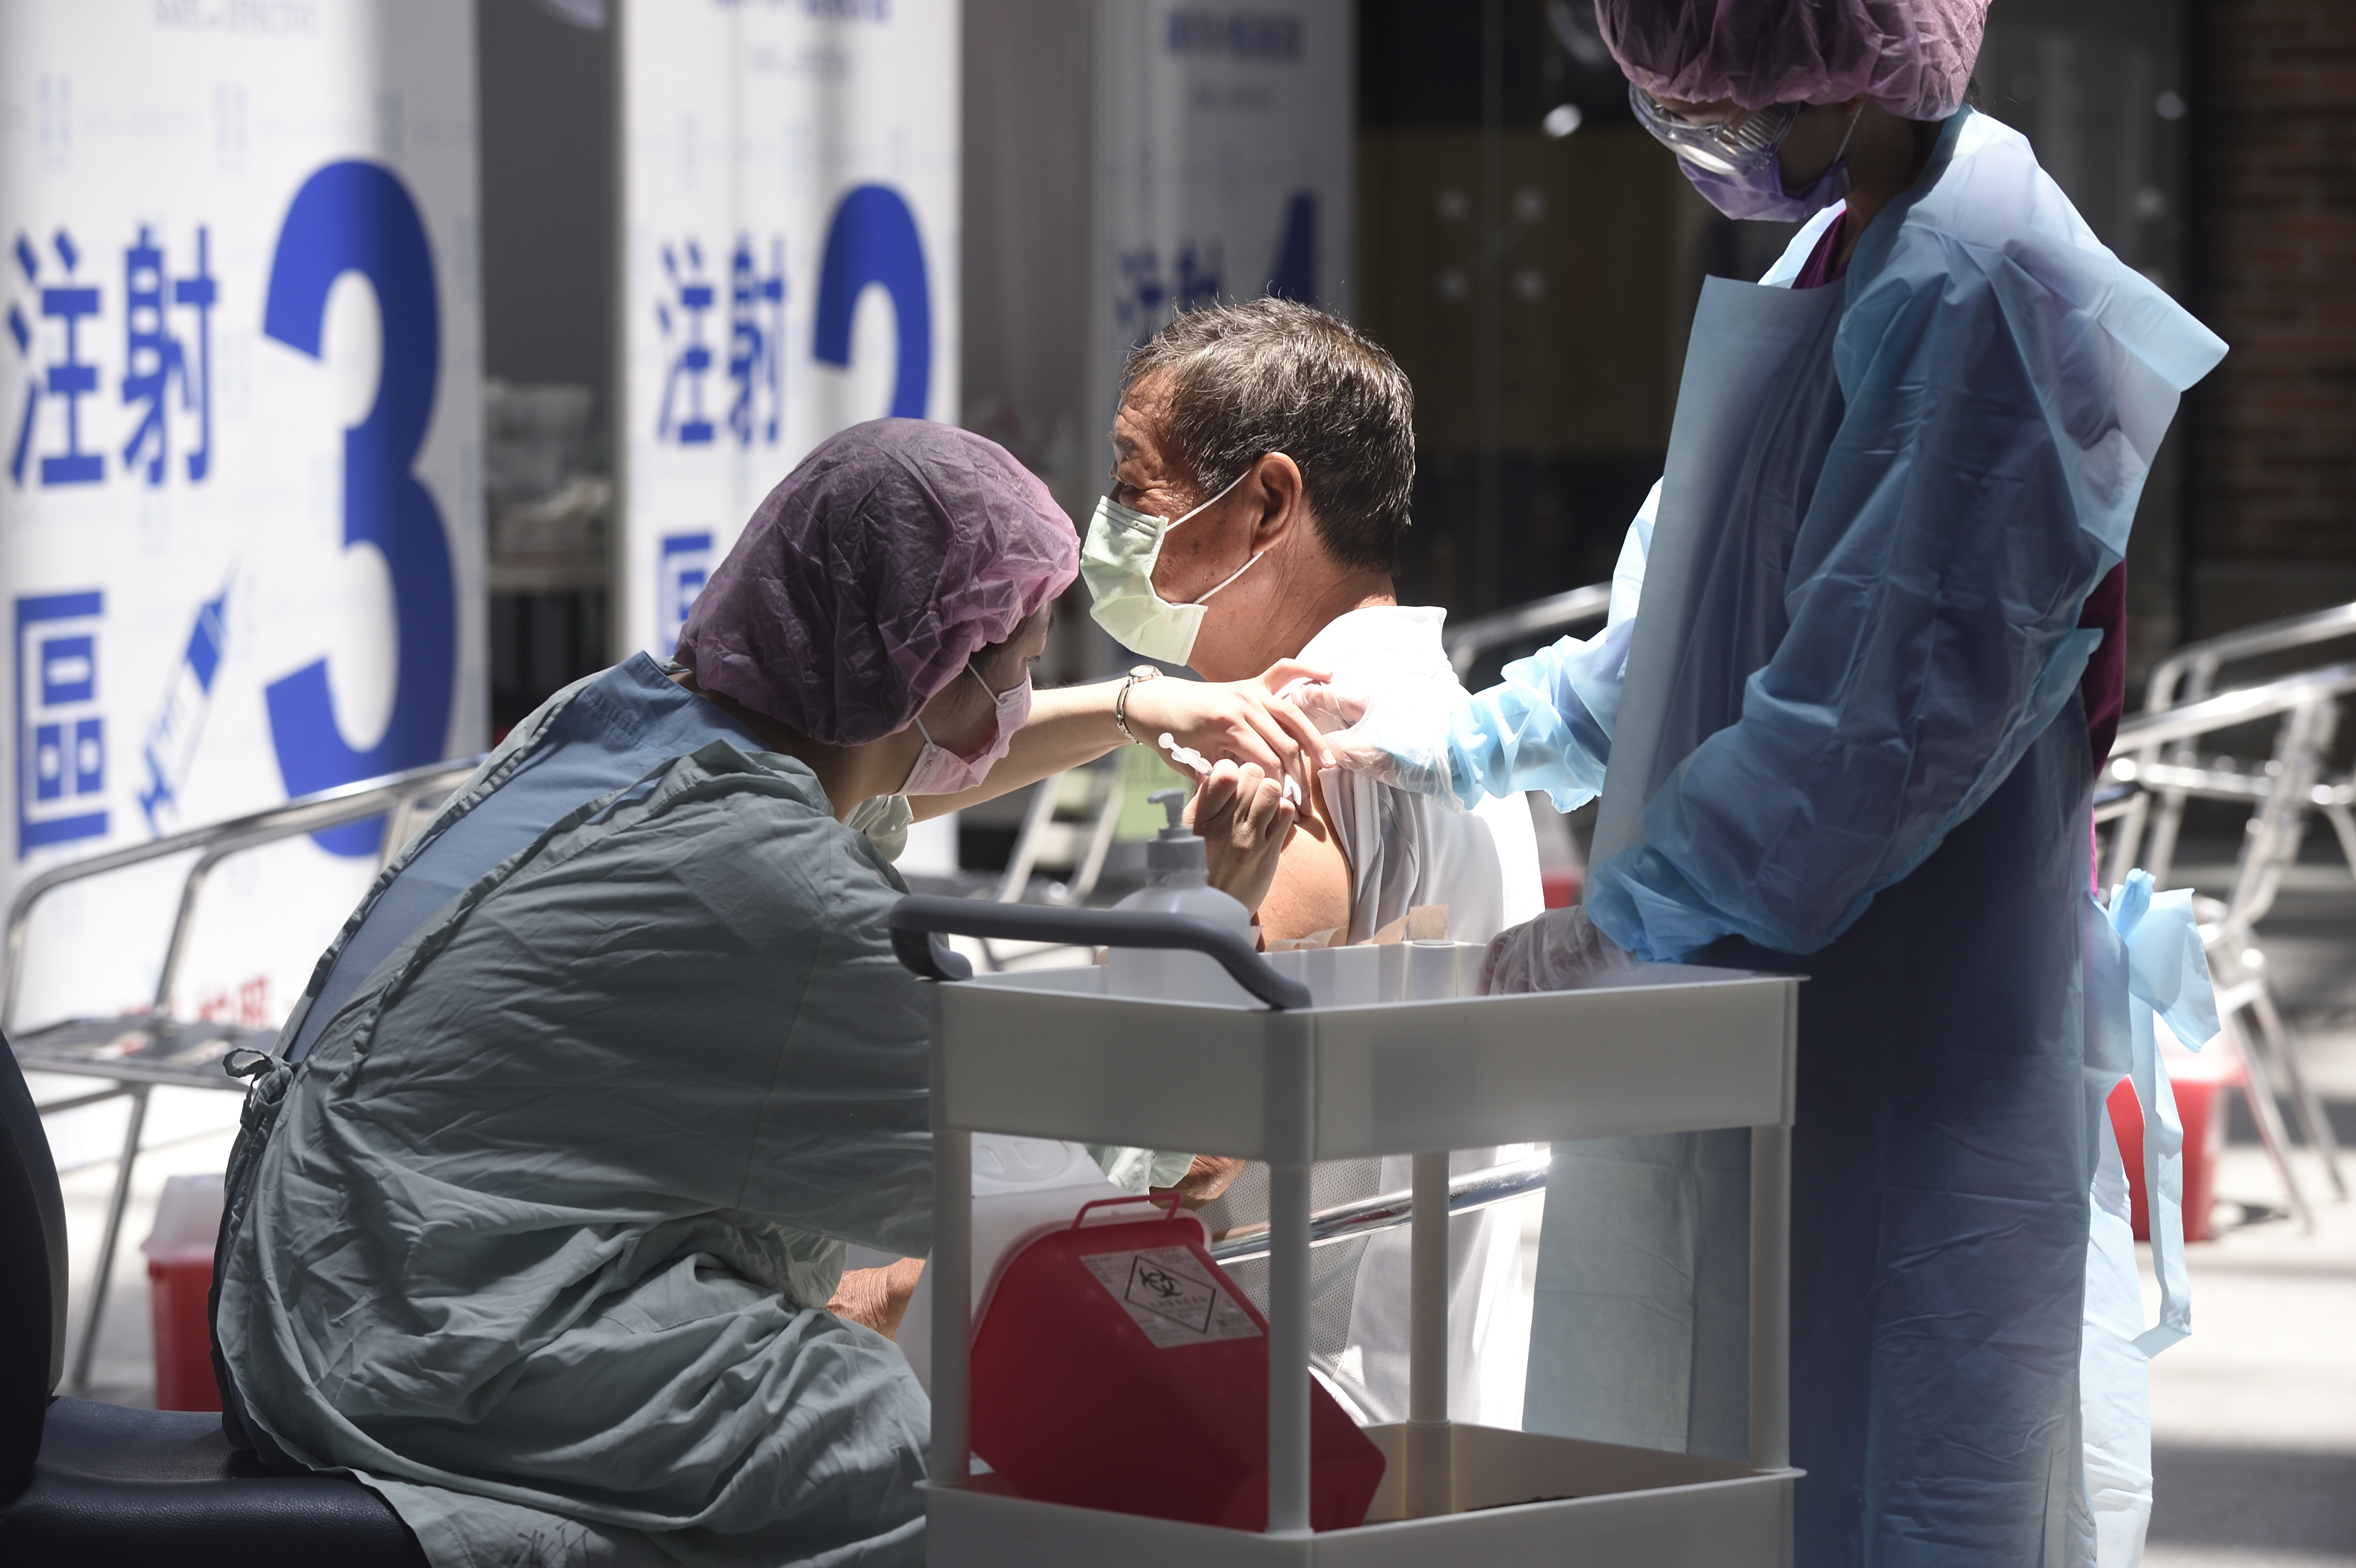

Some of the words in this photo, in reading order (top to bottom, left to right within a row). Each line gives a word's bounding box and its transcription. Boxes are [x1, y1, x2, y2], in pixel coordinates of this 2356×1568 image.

[7, 223, 219, 488] 注射
[656, 233, 786, 446] 注射
[264, 159, 457, 858] 3
[14, 589, 108, 860] 區
